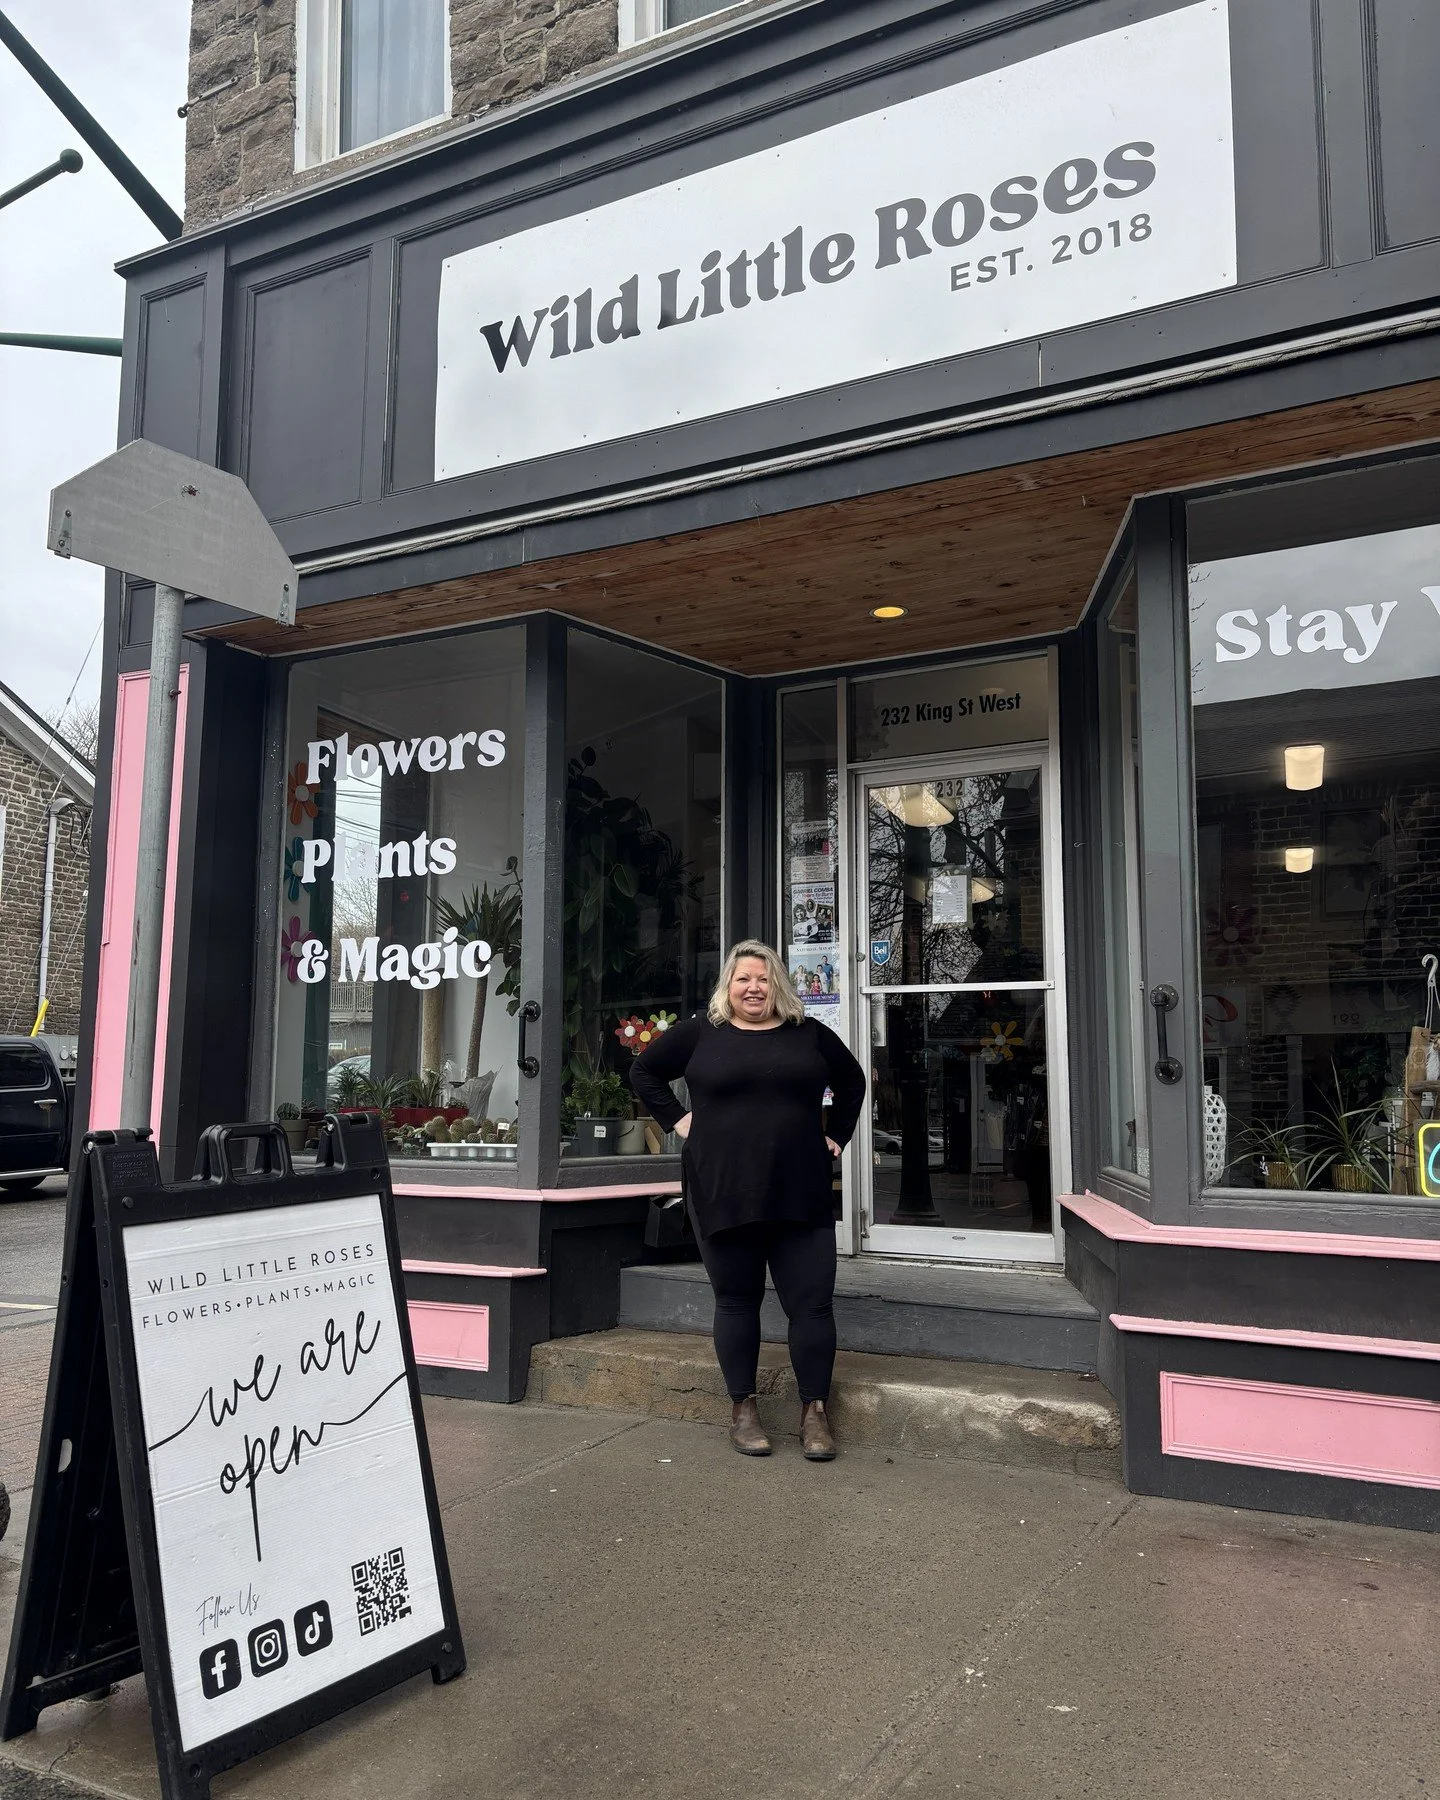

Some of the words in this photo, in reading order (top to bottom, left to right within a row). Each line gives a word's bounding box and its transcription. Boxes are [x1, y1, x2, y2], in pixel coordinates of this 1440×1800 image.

[479, 273, 642, 375] Wild
[656, 226, 856, 331] Little
[874, 141, 1157, 270] Roses
[950, 245, 1034, 292] EST.
[1052, 213, 1152, 265] 2018
[1215, 600, 1398, 664] Stay
[880, 706, 910, 727] 232
[916, 703, 953, 724] King
[958, 697, 974, 716] St
[979, 693, 1021, 713] West
[305, 729, 506, 785] Flowers
[936, 780, 964, 799] 232
[296, 938, 329, 984] &
[337, 926, 492, 990] Magic
[874, 944, 888, 955] Bell
[148, 1271, 208, 1295] WILD
[223, 1257, 297, 1283] LITTLE
[310, 1243, 376, 1268] ROSES
[300, 1310, 381, 1375] are
[195, 1594, 236, 1636] Follow
[239, 1582, 260, 1616] Us
